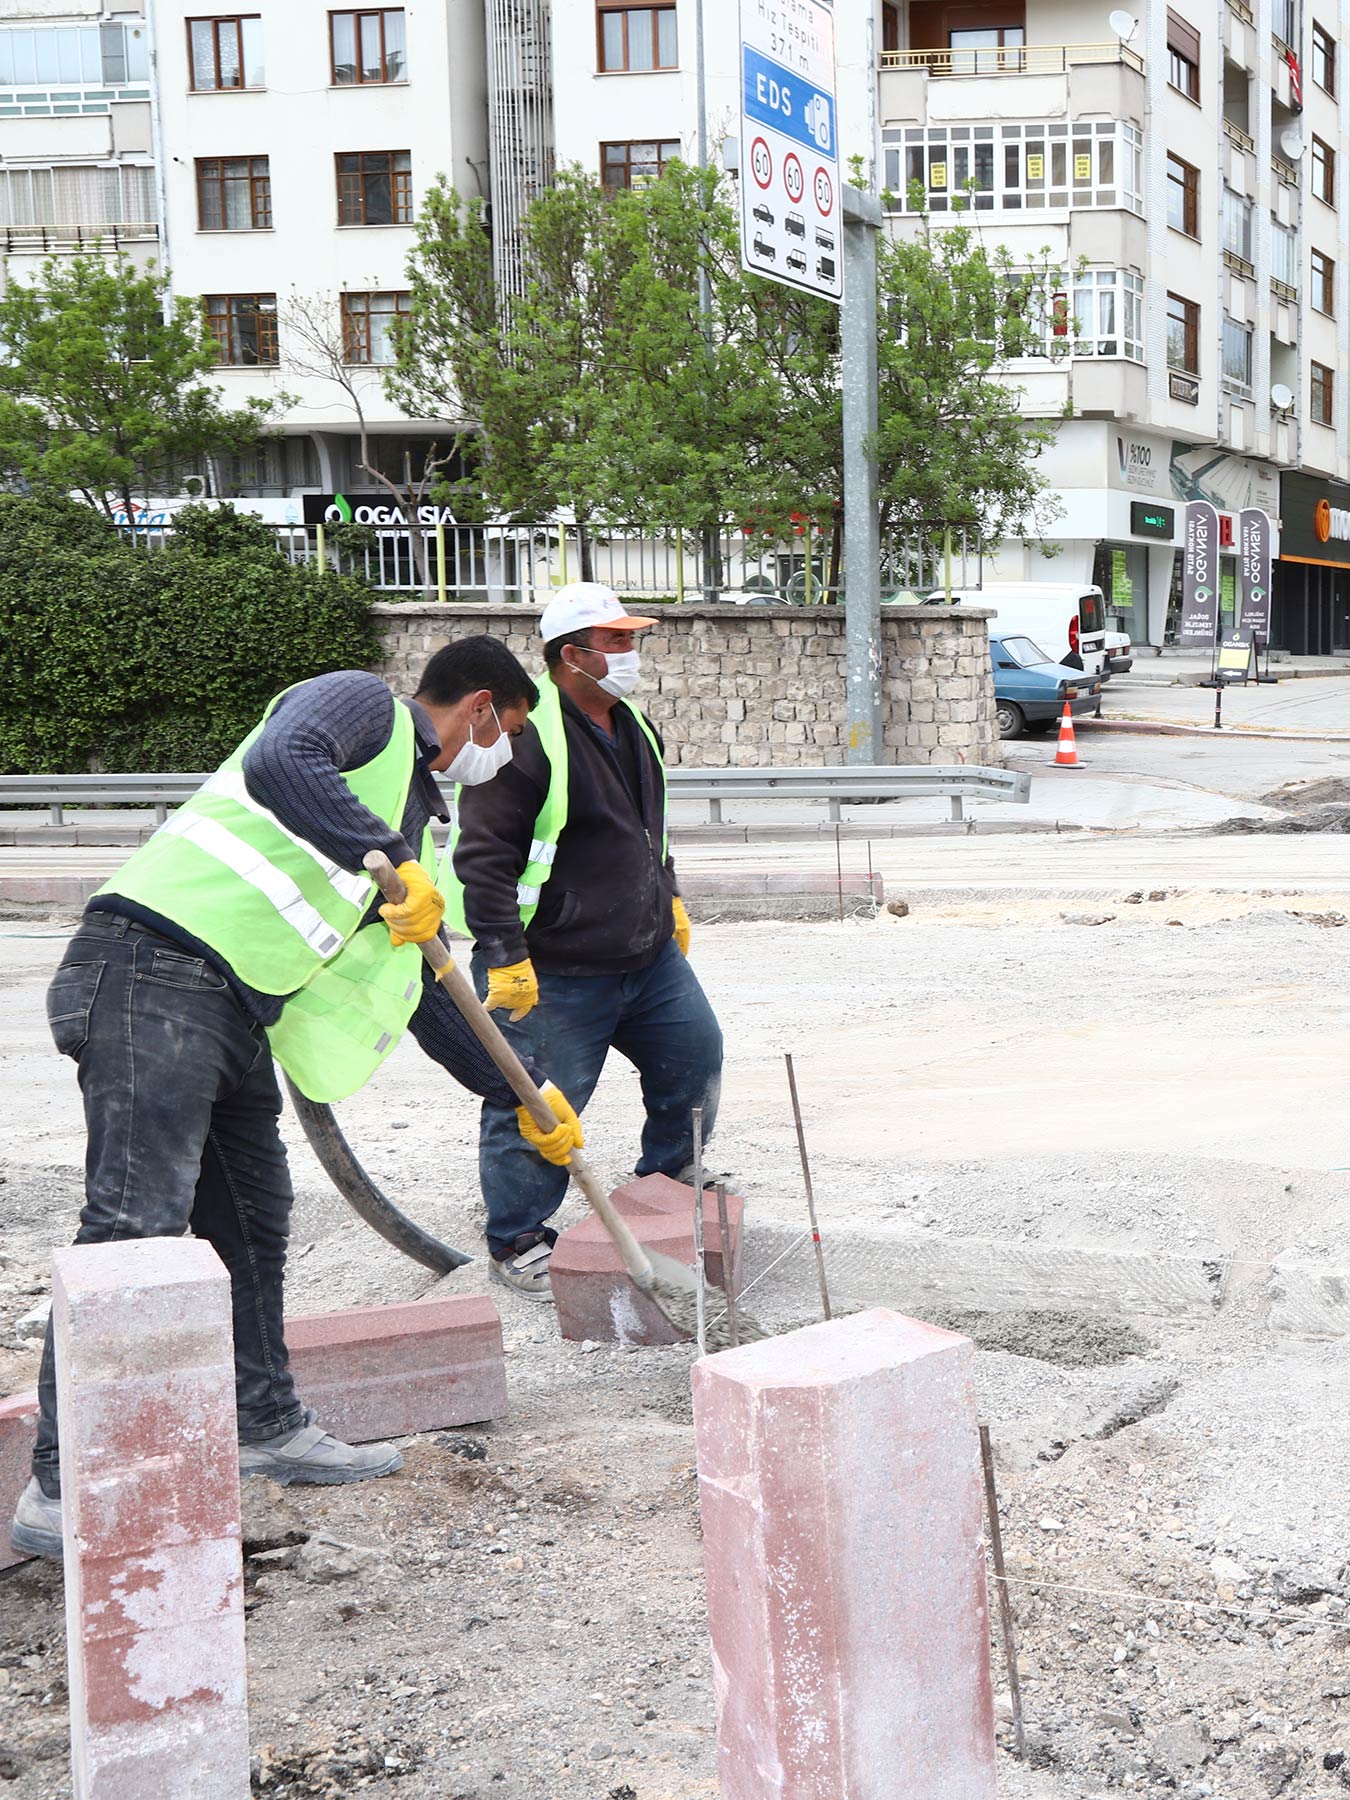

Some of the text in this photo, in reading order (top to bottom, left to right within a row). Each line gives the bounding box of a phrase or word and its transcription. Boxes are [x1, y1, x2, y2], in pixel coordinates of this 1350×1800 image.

[781, 12, 819, 52] Tespiti
[771, 33, 809, 71] 371 m
[757, 72, 792, 116] EDS
[755, 151, 769, 176] 60
[787, 166, 800, 191] 60
[818, 178, 830, 203] 50
[355, 506, 457, 524] OGASIA
